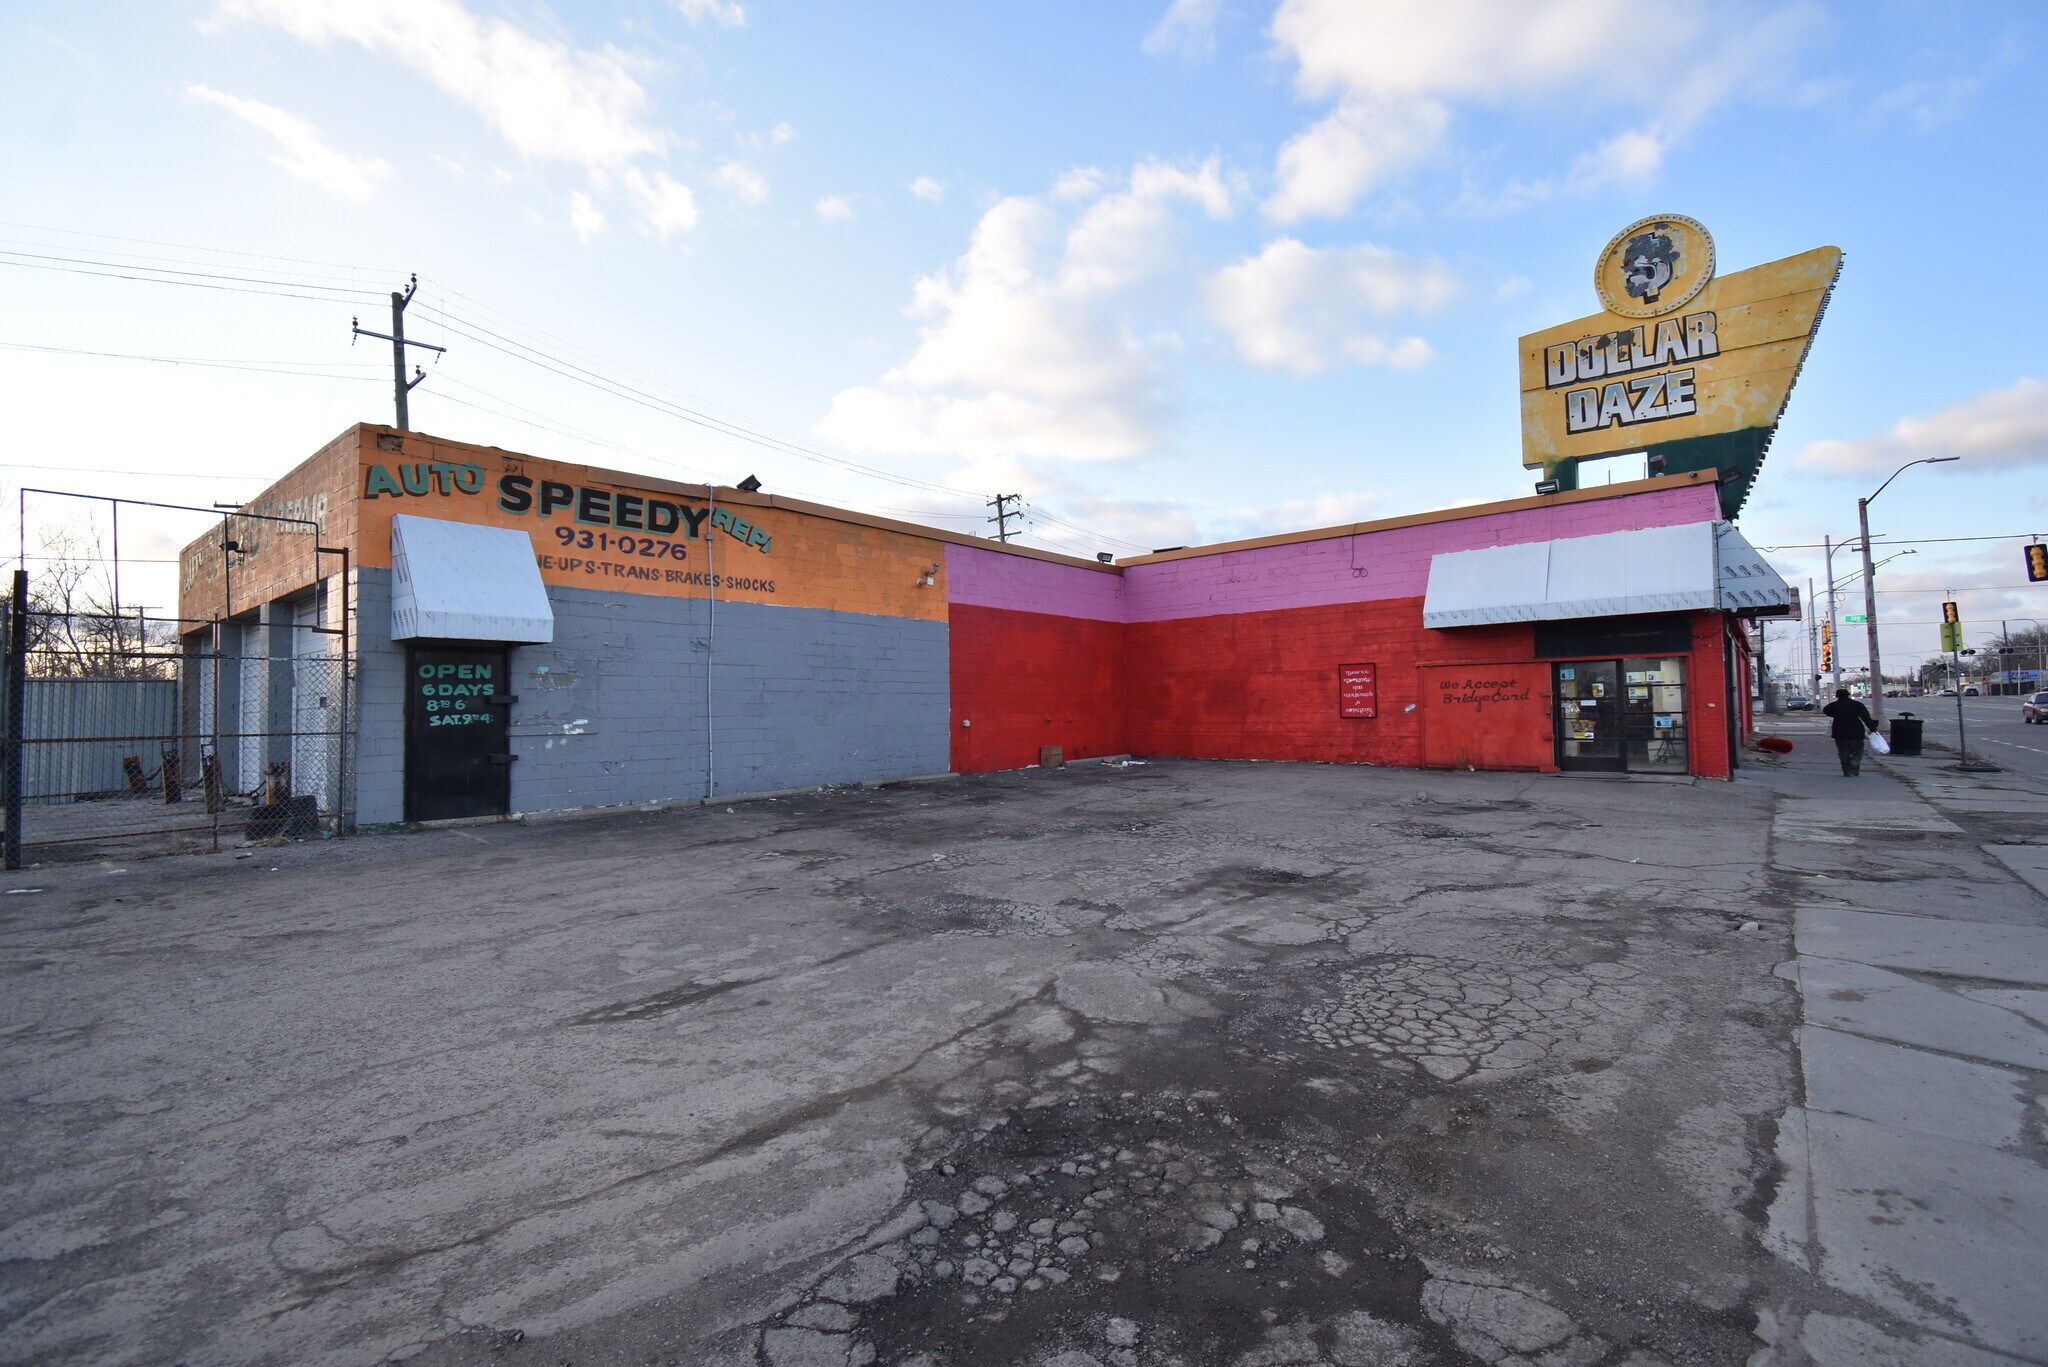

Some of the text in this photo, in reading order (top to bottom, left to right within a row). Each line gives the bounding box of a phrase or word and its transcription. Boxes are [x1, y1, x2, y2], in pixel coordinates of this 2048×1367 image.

[1545, 311, 1720, 390] DOLLAR
[1566, 368, 1697, 435] DAZE
[363, 463, 486, 499] AUTO
[496, 474, 710, 540] SPEEDY
[419, 664, 492, 679] OPEN
[422, 683, 495, 696] 6 DAYS
[1440, 679, 1518, 695] We Accept
